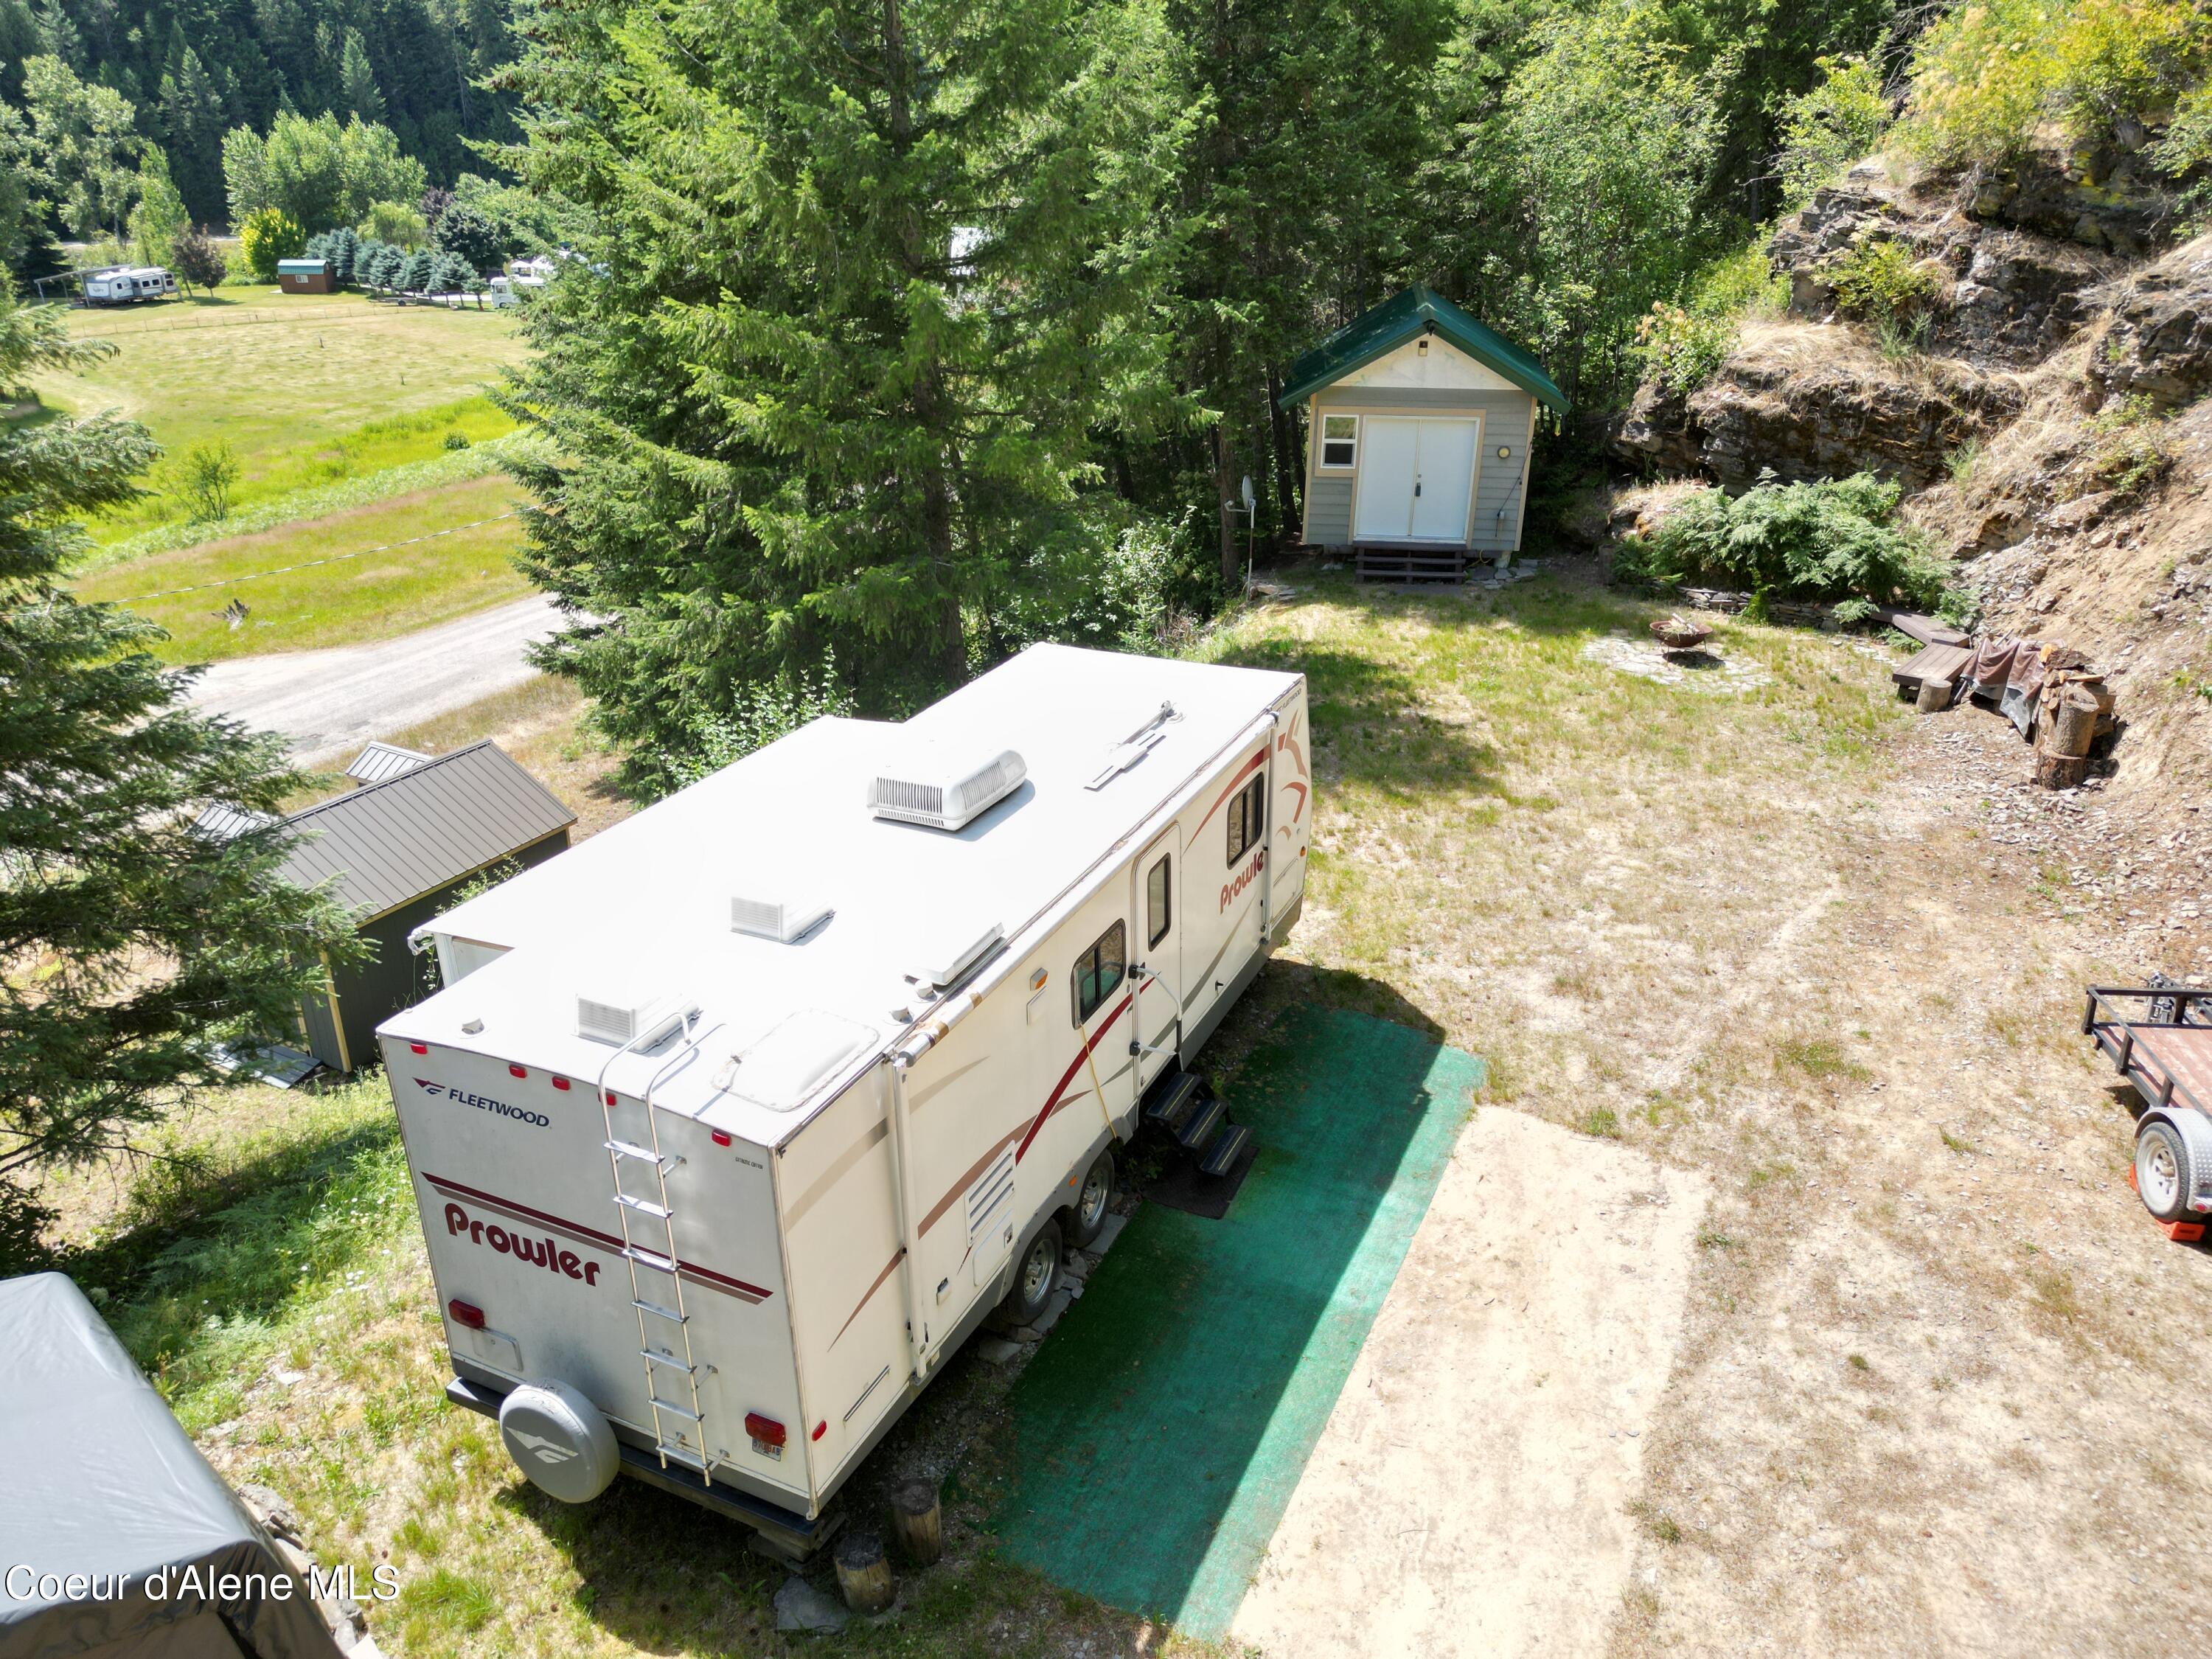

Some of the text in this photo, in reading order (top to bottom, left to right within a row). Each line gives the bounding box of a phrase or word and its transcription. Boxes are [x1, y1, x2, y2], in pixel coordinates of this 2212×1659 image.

[1220, 851, 1264, 915] Prowle
[449, 1088, 549, 1127] FLEETWOOD
[444, 1203, 601, 1287] Prowler
